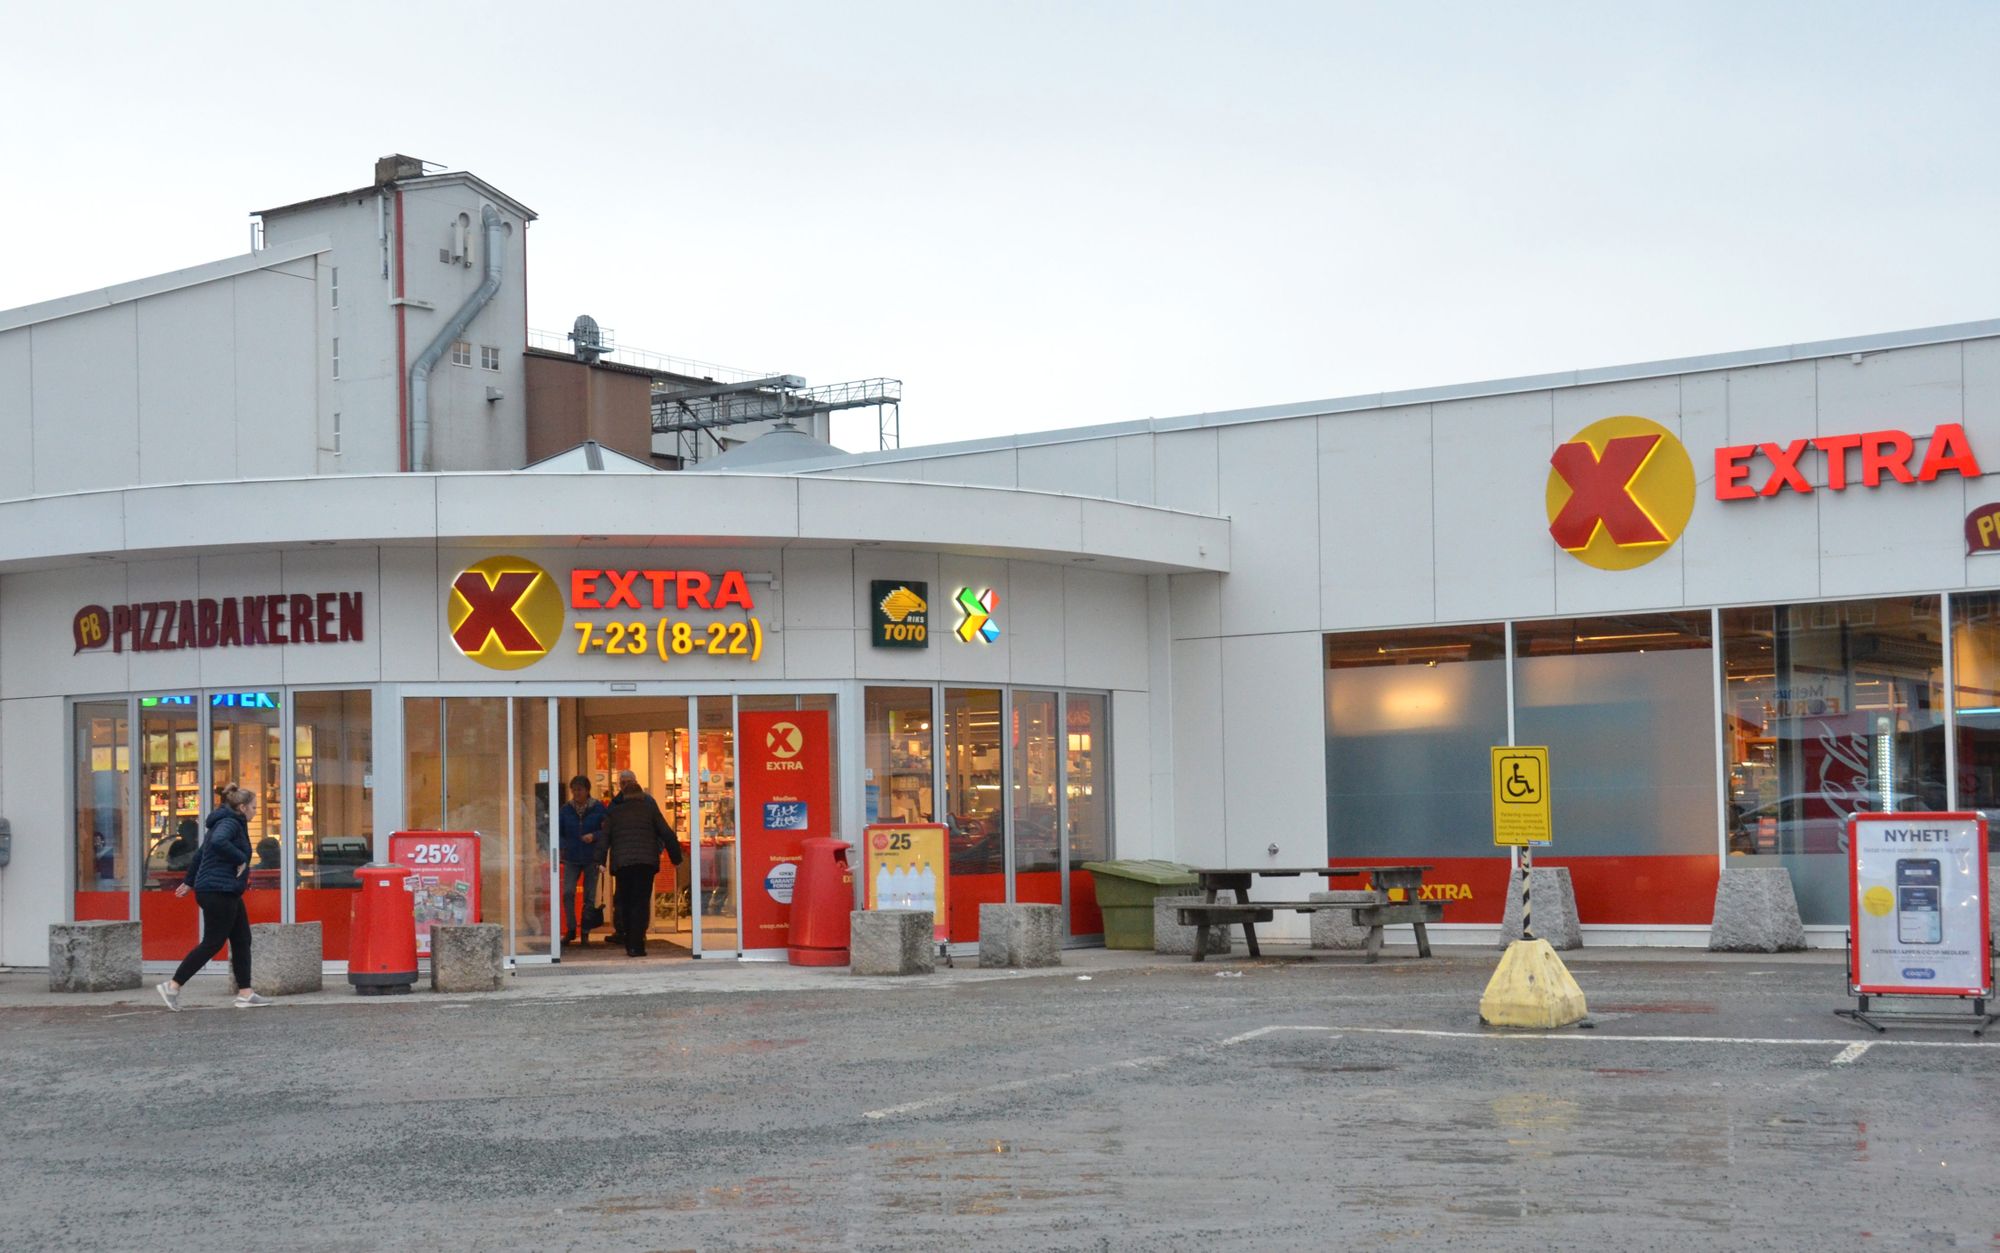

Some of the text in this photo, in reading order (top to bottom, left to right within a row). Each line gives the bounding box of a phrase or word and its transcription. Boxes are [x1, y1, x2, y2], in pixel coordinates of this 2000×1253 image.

[1715, 423, 1981, 500] EXTRA
[571, 569, 754, 609] EXTRA
[80, 613, 101, 645] PB
[112, 592, 363, 653] PIZZABAKEREN
[884, 624, 926, 641] TOTO
[574, 617, 763, 662] 7-23 (8-22)
[766, 761, 804, 771] EXTRA
[890, 833, 911, 850] 25
[1884, 829, 1949, 842] NYHET!
[407, 844, 459, 864] -25%
